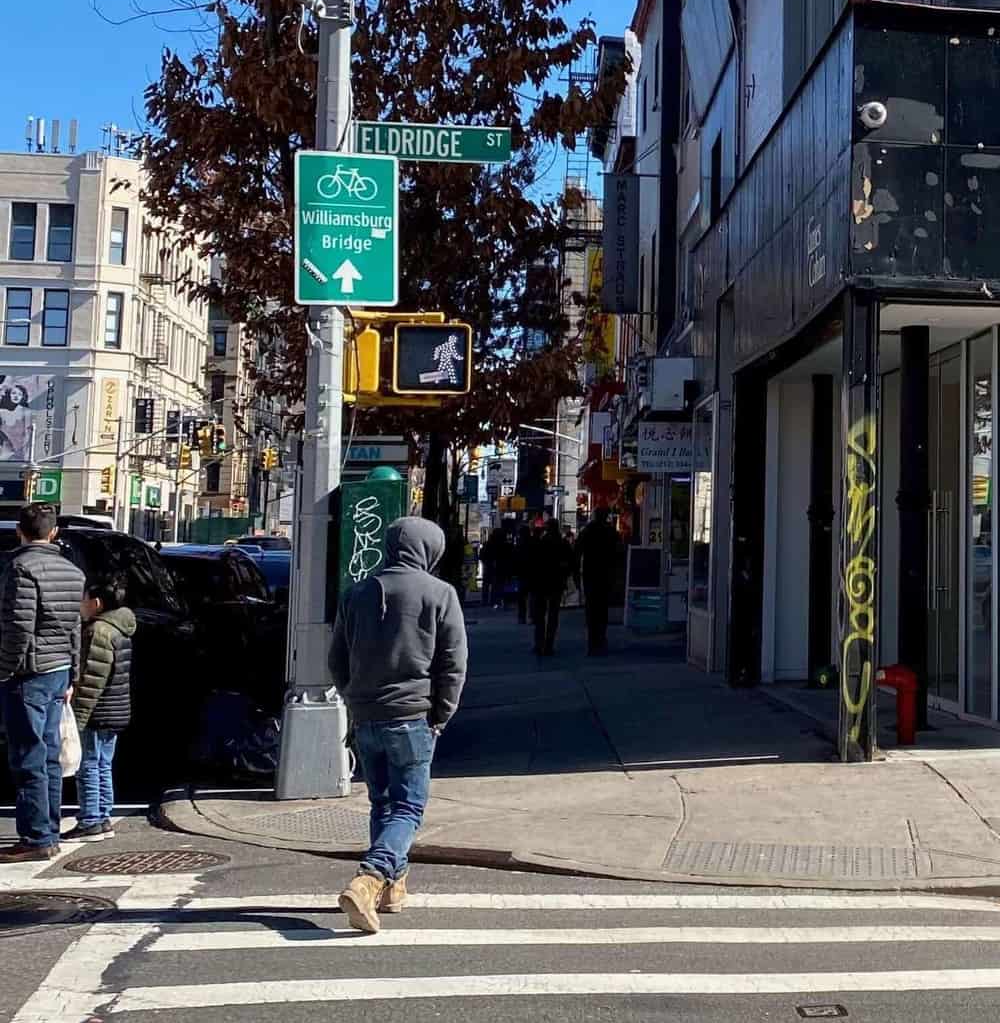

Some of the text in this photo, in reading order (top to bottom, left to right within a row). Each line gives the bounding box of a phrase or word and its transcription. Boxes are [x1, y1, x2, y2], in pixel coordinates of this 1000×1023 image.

[360, 126, 504, 158] ELDRIDGE ST
[301, 209, 393, 231] Williamsburg
[322, 234, 373, 254] Bridge
[104, 395, 113, 433] ZARN
